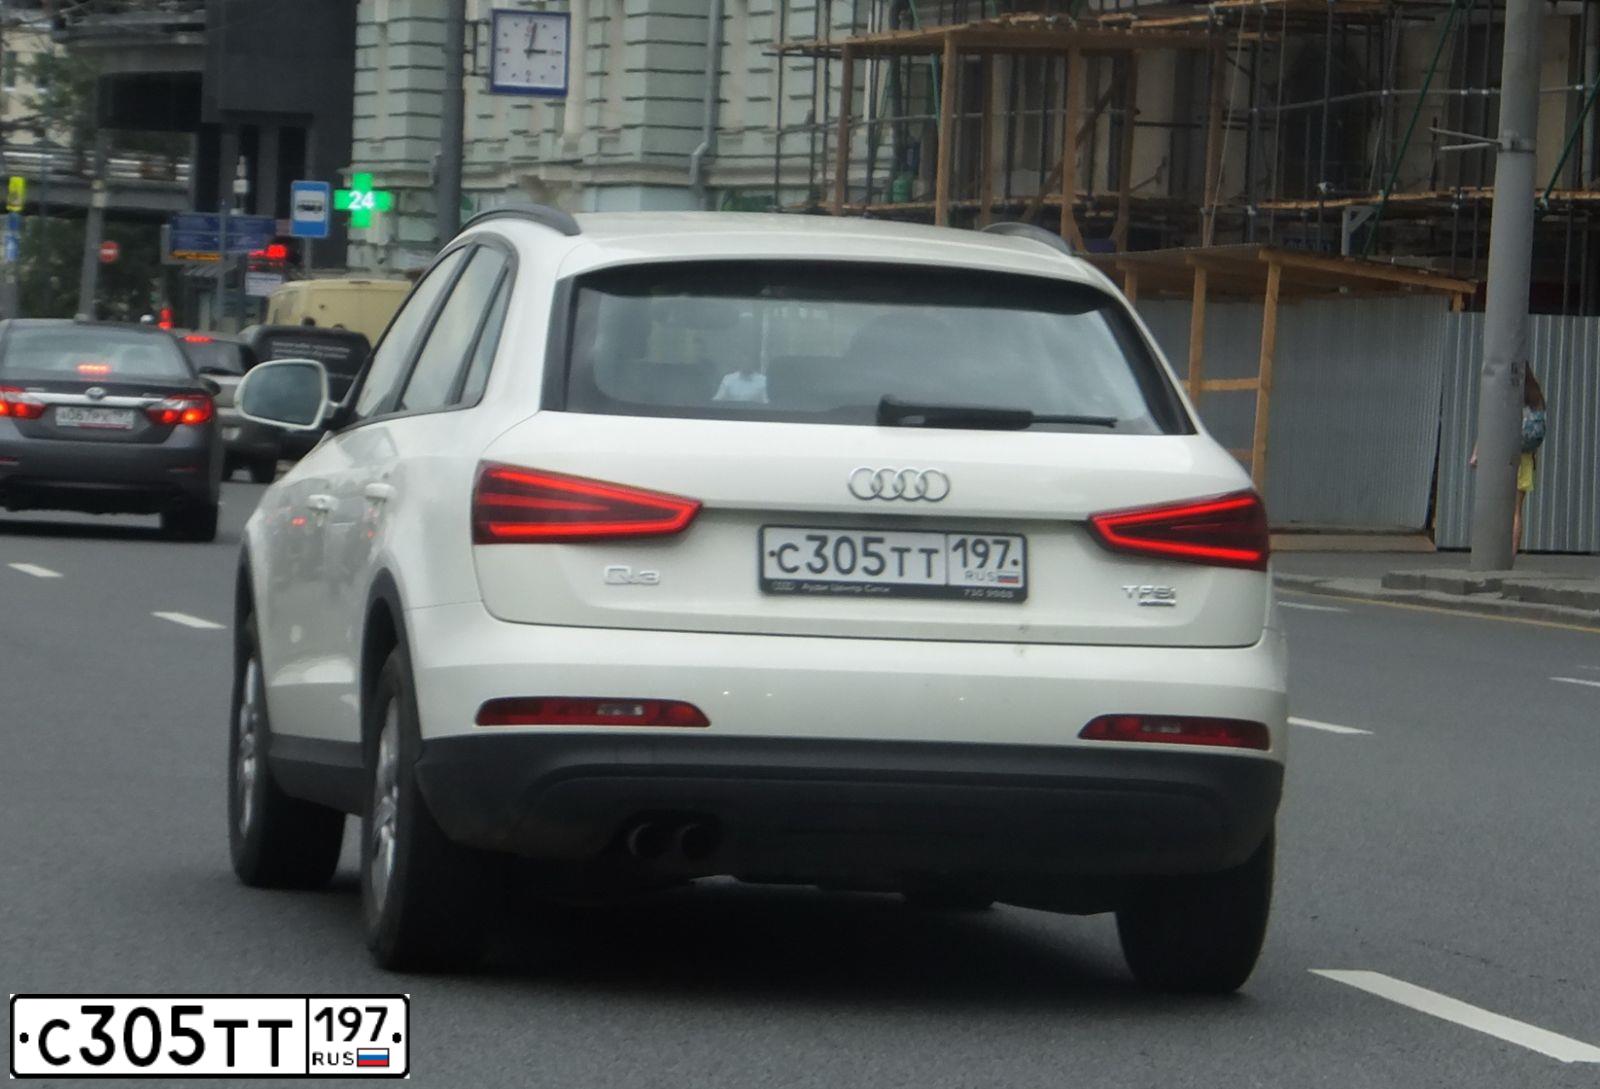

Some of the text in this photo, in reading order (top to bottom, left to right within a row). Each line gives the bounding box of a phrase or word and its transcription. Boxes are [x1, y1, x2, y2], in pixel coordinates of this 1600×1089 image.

[348, 190, 375, 209] 24
[776, 535, 1012, 579] C305TT 197
[965, 570, 996, 582] RUS
